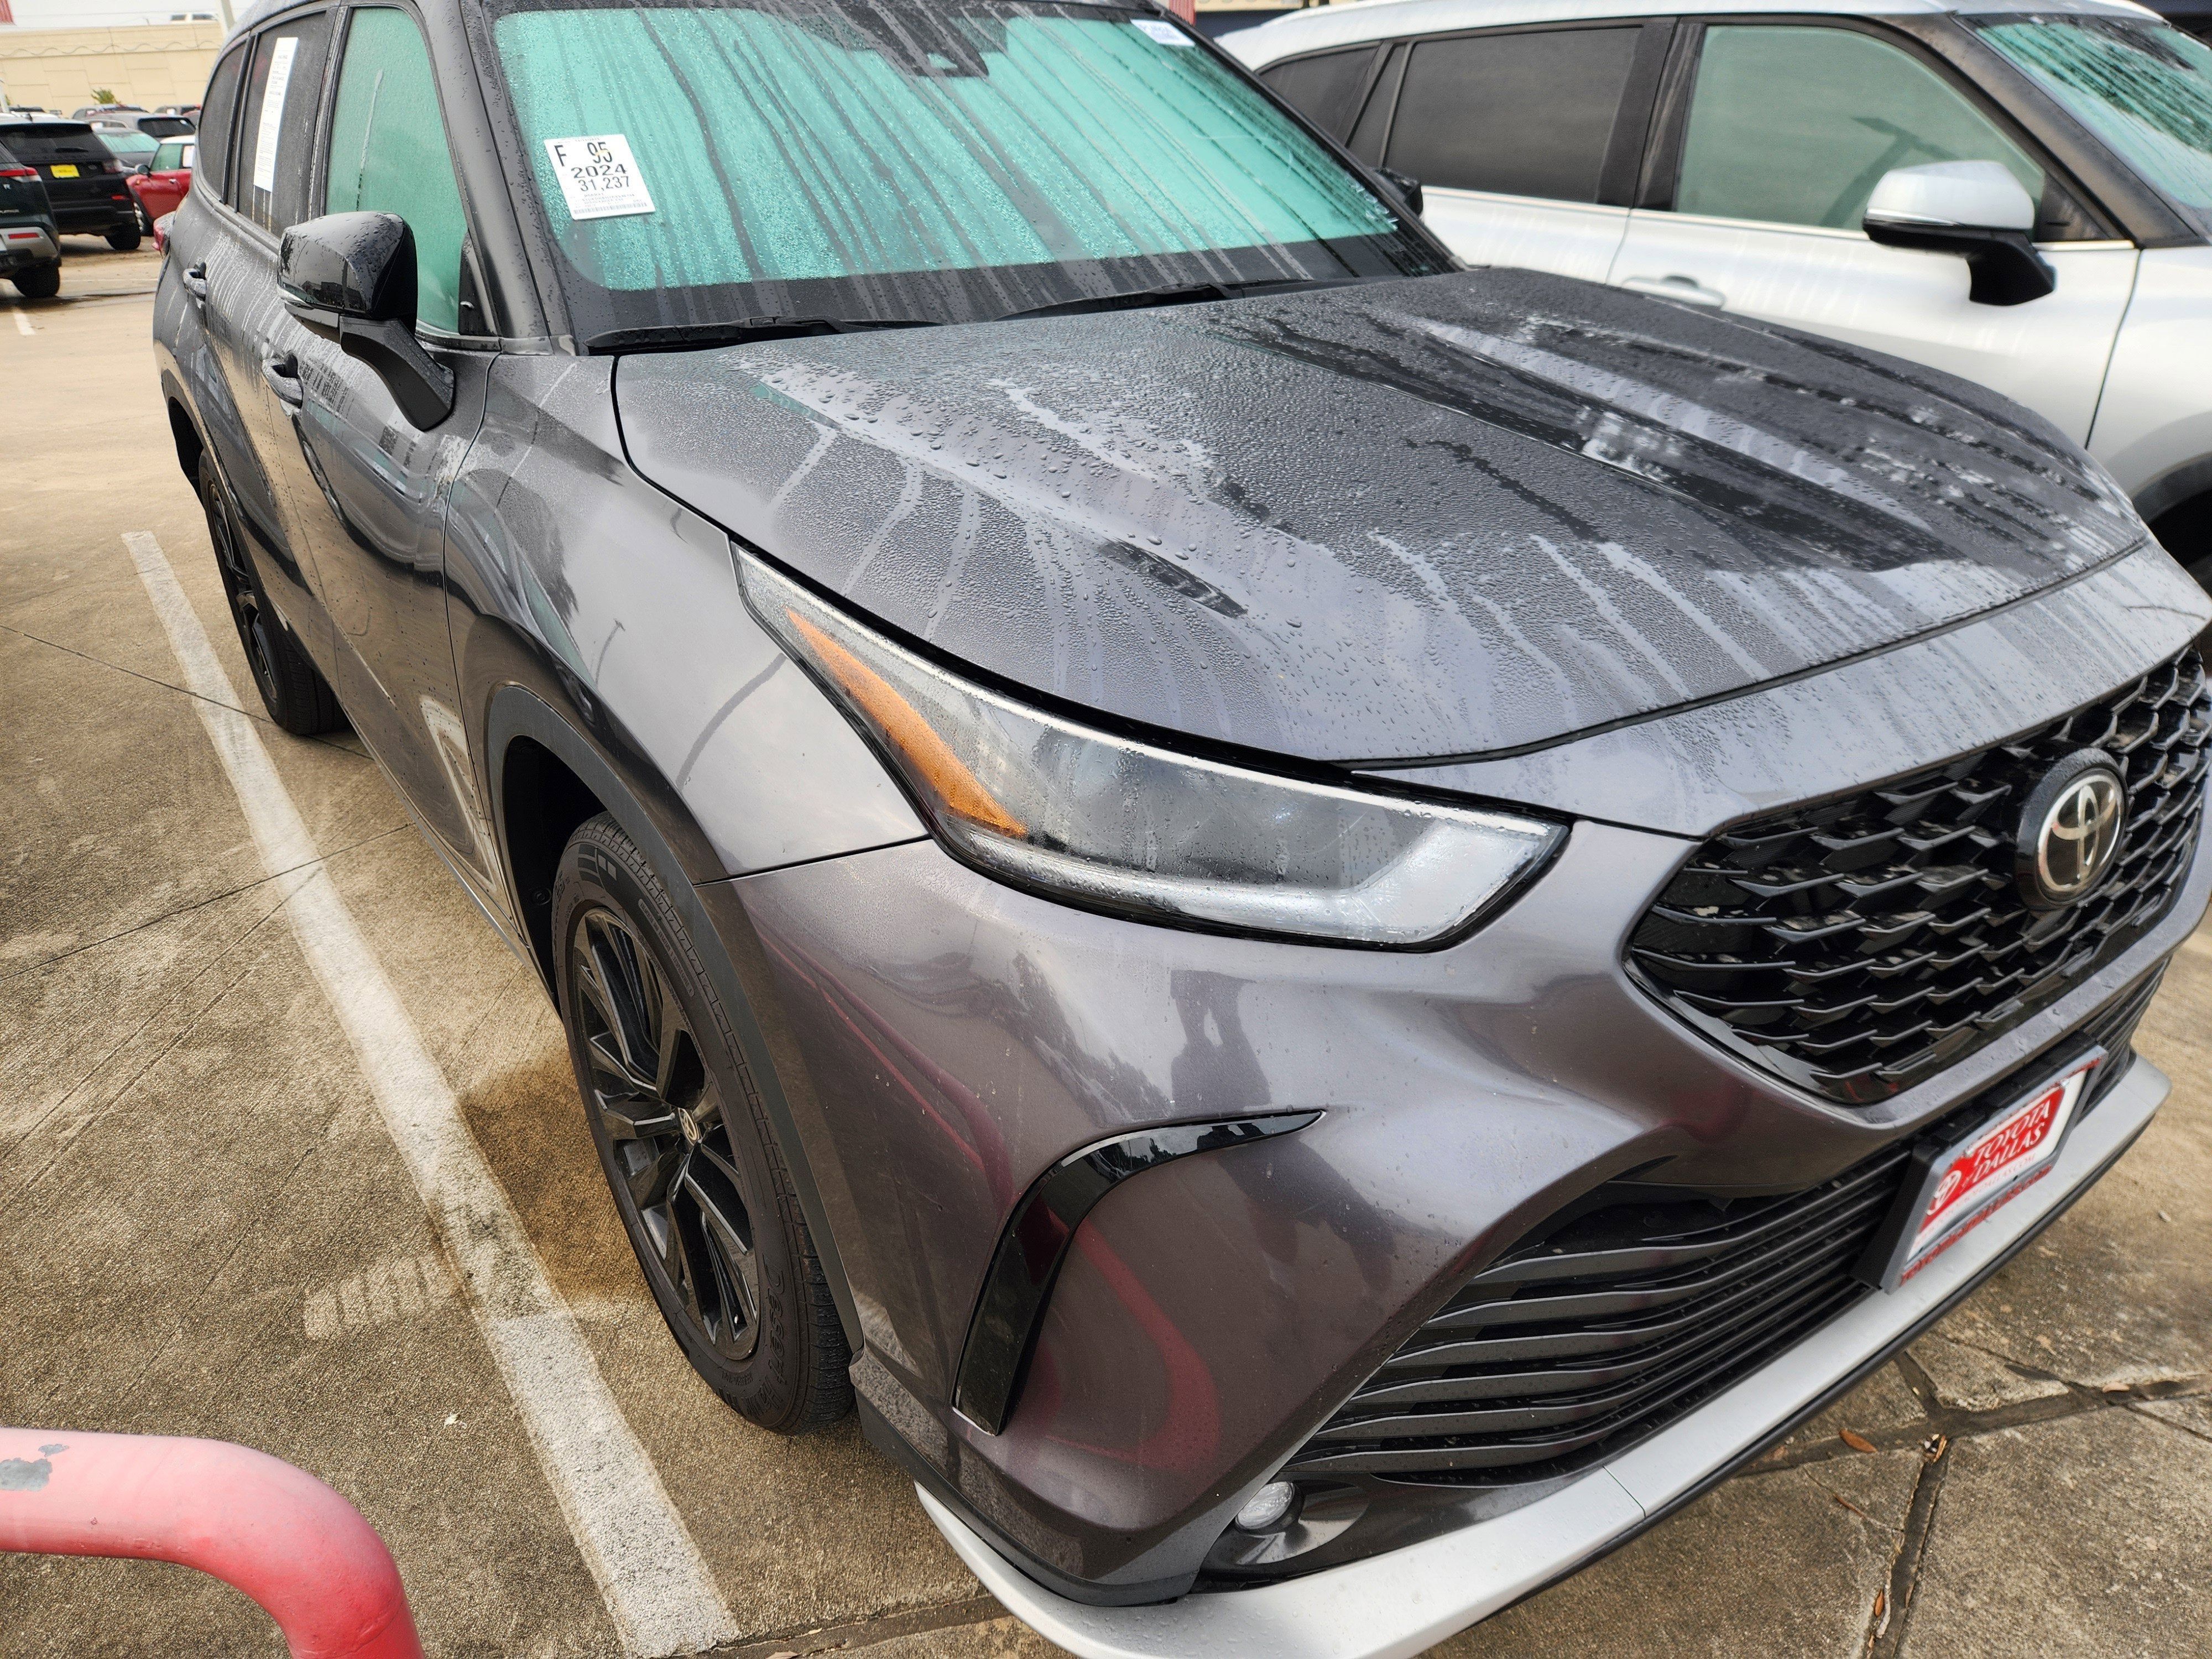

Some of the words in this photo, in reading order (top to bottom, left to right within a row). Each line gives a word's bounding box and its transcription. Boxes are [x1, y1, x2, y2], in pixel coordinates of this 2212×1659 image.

[554, 145, 567, 166] F
[587, 142, 613, 164] 95
[571, 164, 627, 179] 2024
[578, 175, 629, 191] 31,237
[1973, 1100, 2051, 1167] TOYOTA
[1974, 1122, 2045, 1182] DALLAS
[761, 1253, 787, 1385] Desert
